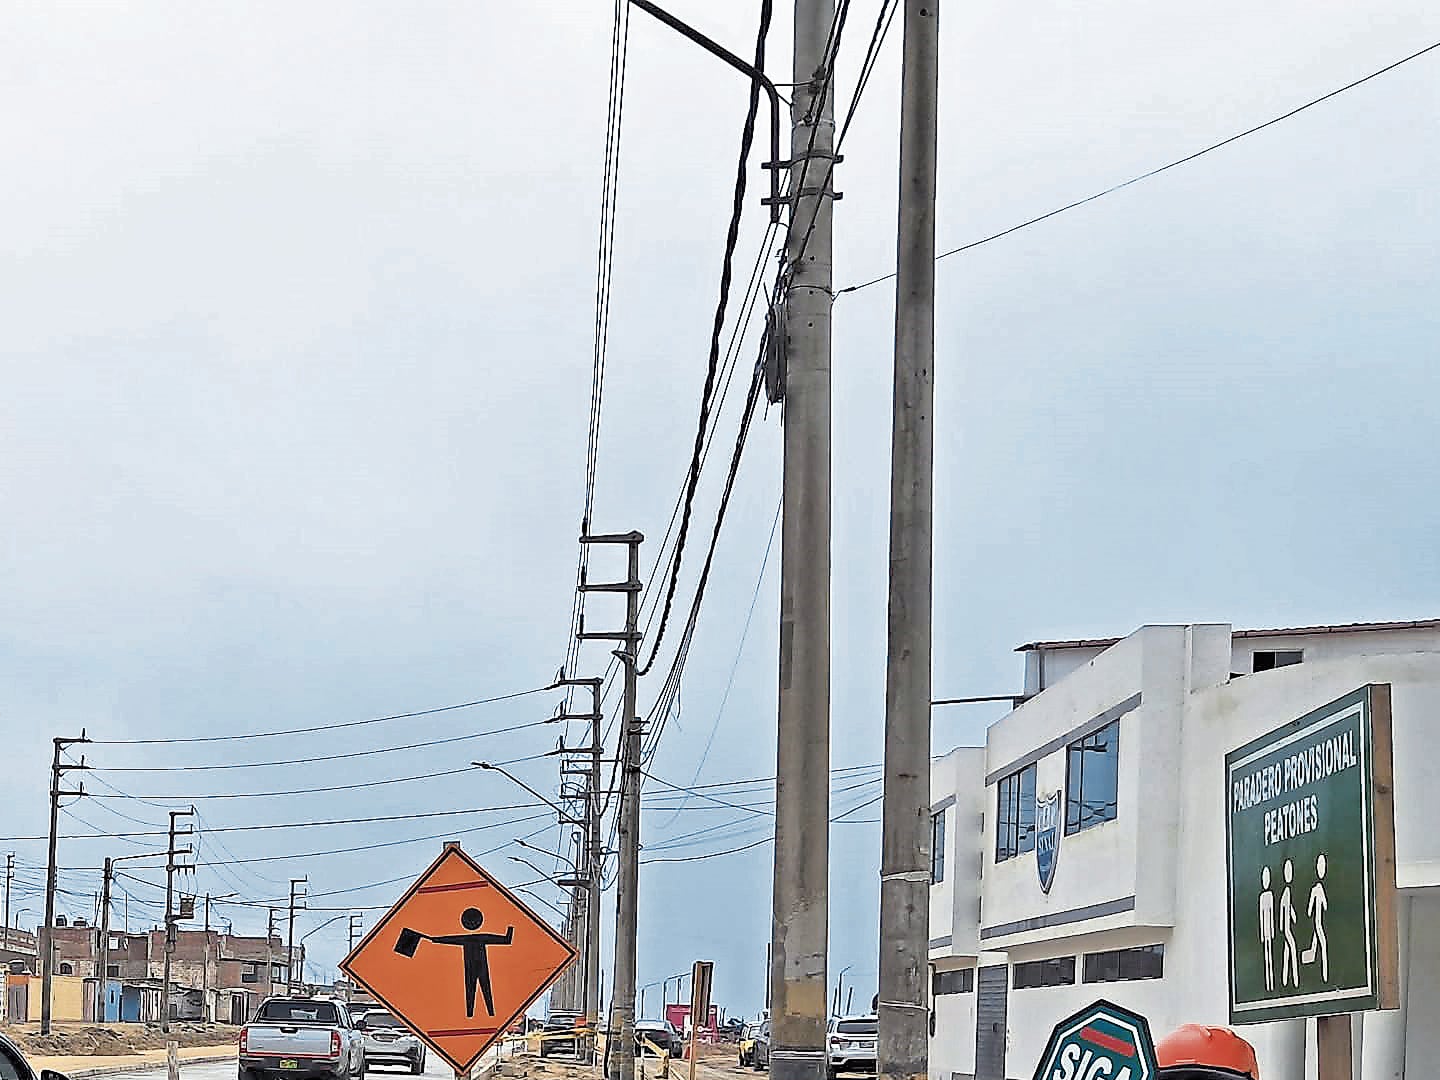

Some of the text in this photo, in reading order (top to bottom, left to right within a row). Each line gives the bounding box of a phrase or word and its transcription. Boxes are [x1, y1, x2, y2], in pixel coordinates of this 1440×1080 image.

[1233, 730, 1357, 813] PARADERO PROVISIONAL
[1264, 794, 1318, 846] PEATONES
